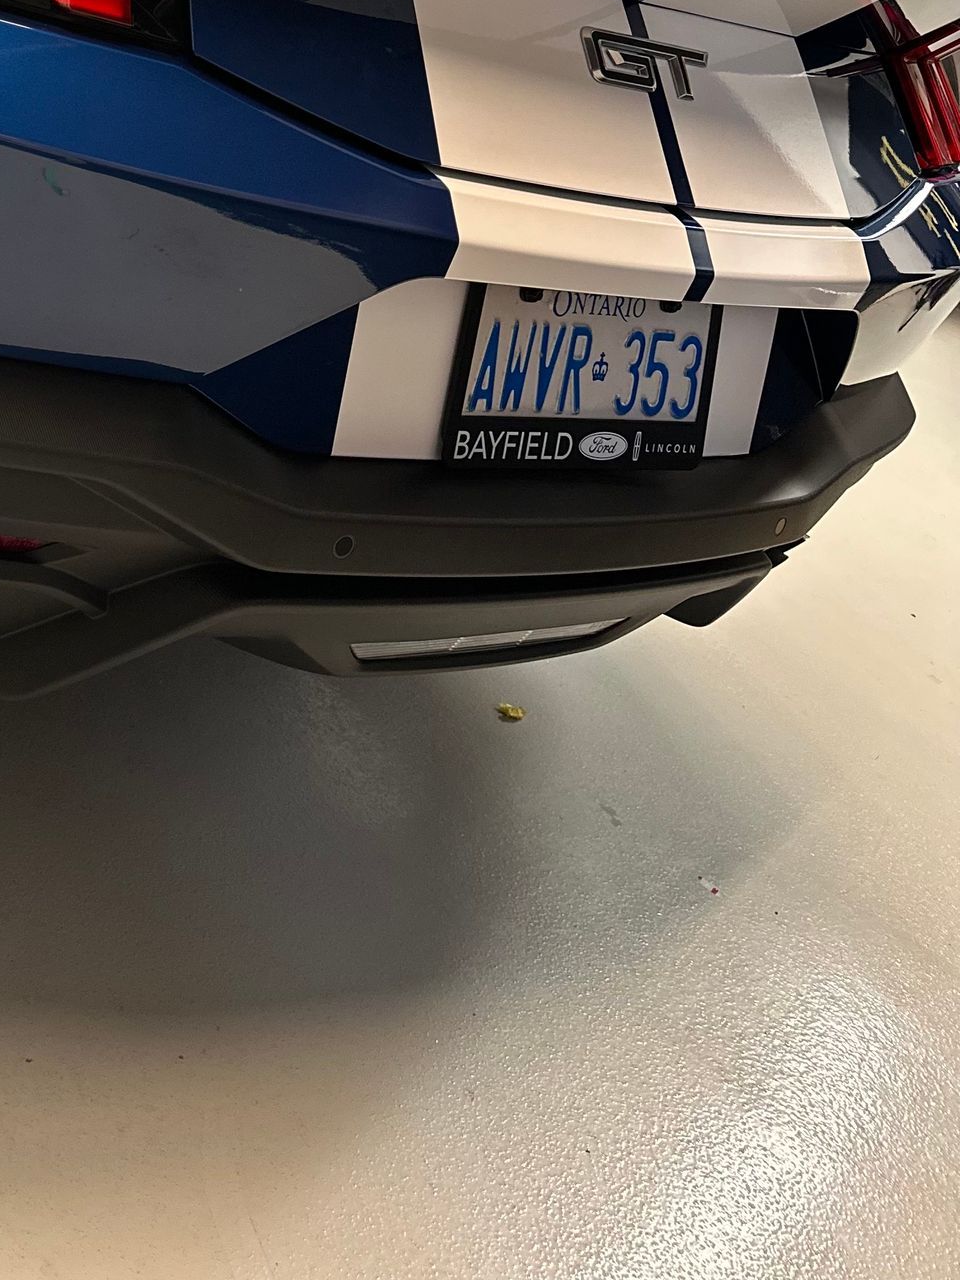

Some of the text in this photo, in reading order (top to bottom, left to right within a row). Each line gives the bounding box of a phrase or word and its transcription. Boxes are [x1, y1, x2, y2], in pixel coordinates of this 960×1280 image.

[580, 26, 709, 101] GT
[551, 290, 647, 322] ONTARIO
[464, 318, 703, 420] AWVR 353
[453, 430, 574, 461] BAYFIELD
[644, 442, 697, 455] LINCOLN
